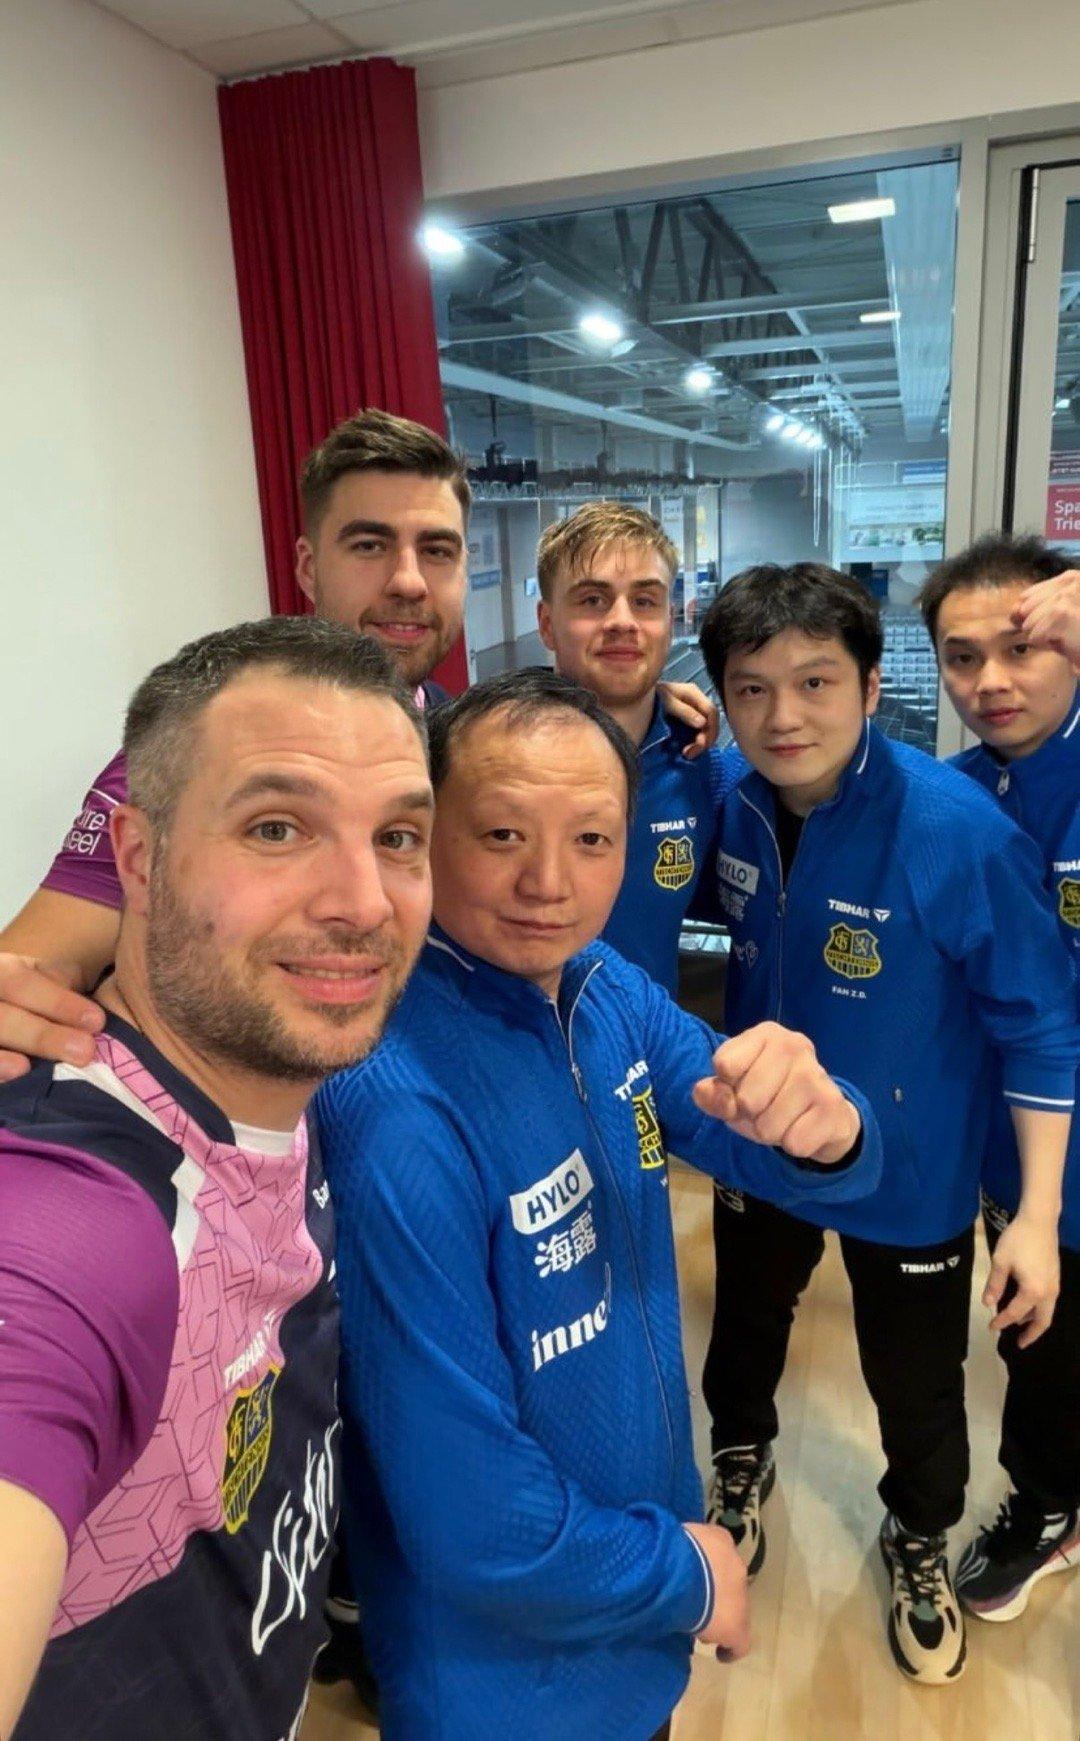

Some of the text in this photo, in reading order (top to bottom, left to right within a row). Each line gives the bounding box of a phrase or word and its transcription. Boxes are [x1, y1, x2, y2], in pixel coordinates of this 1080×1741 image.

[650, 819, 686, 834] TIBHAR
[828, 899, 871, 920] TIBHAR
[614, 1060, 650, 1101] TIAR
[526, 1169, 580, 1225] HYLO
[534, 1209, 597, 1279] 海露
[900, 1262, 945, 1274] TIBHAR
[224, 1331, 268, 1391] TIBHAR
